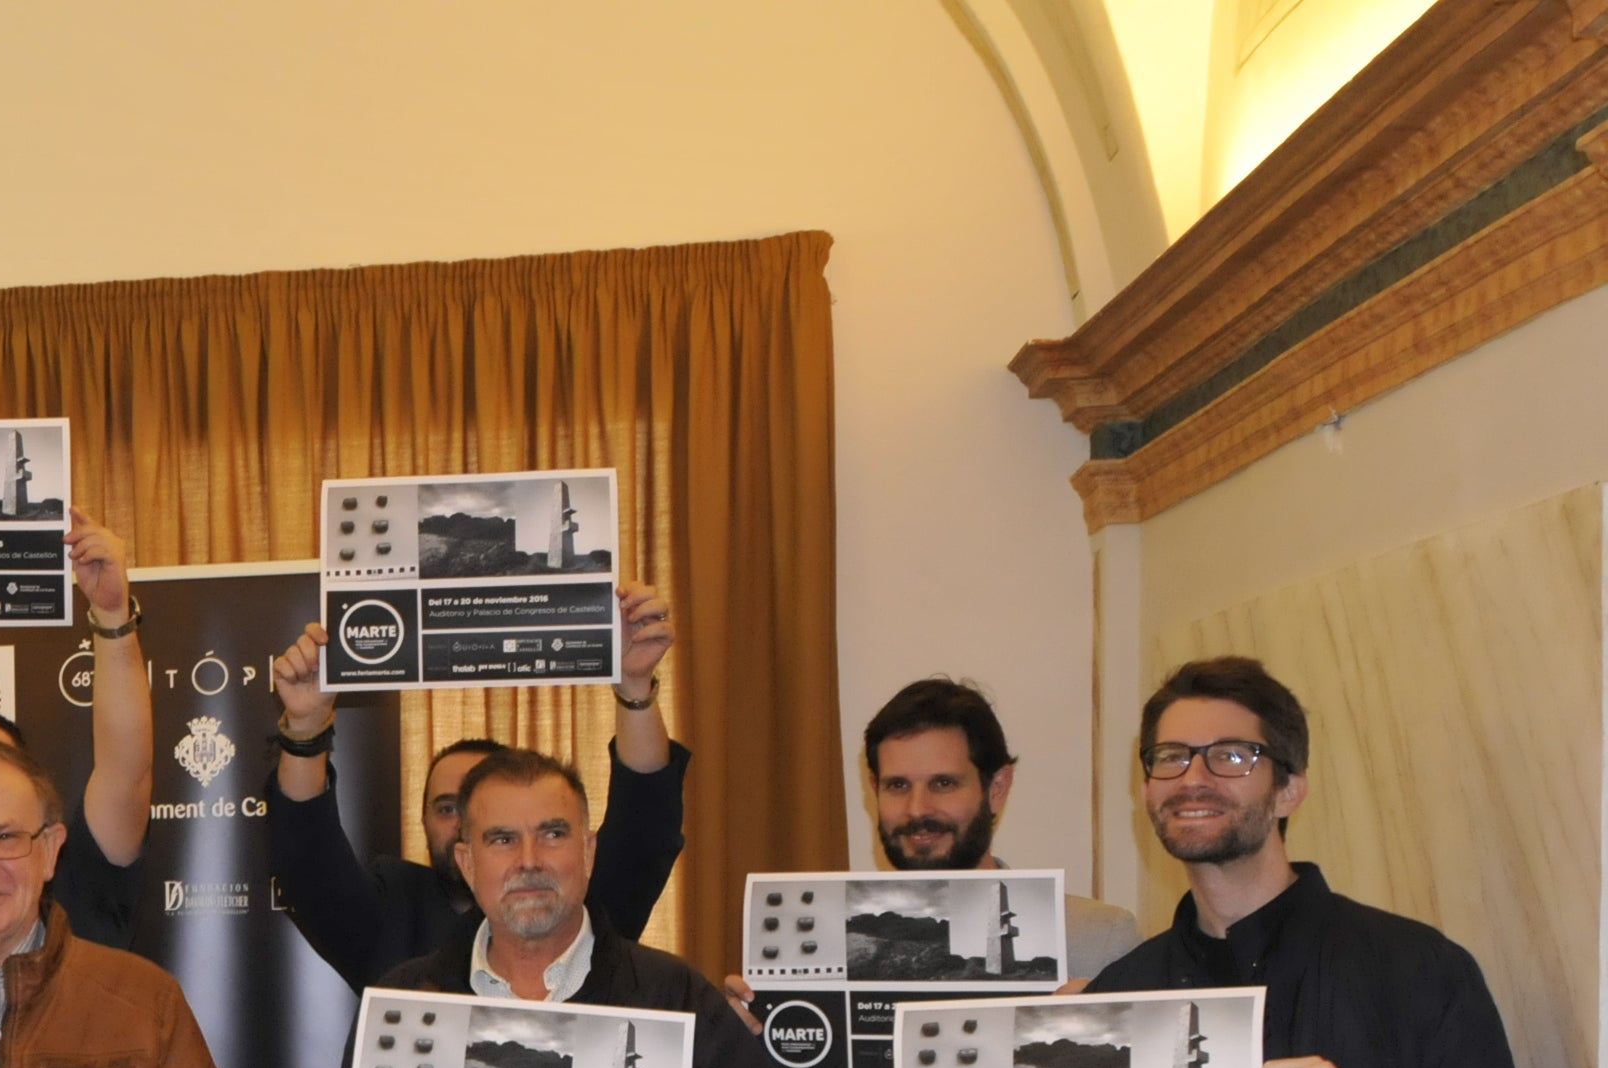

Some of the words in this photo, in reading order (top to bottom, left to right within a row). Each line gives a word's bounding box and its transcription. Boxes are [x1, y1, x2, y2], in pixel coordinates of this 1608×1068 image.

[428, 598, 442, 606] Del
[443, 598, 452, 606] 17
[460, 597, 471, 605] 20
[472, 597, 483, 605] de
[484, 595, 528, 604] noviembre
[346, 625, 397, 639] MARTE
[212, 798, 235, 816] de
[772, 1028, 824, 1041] MARTE
